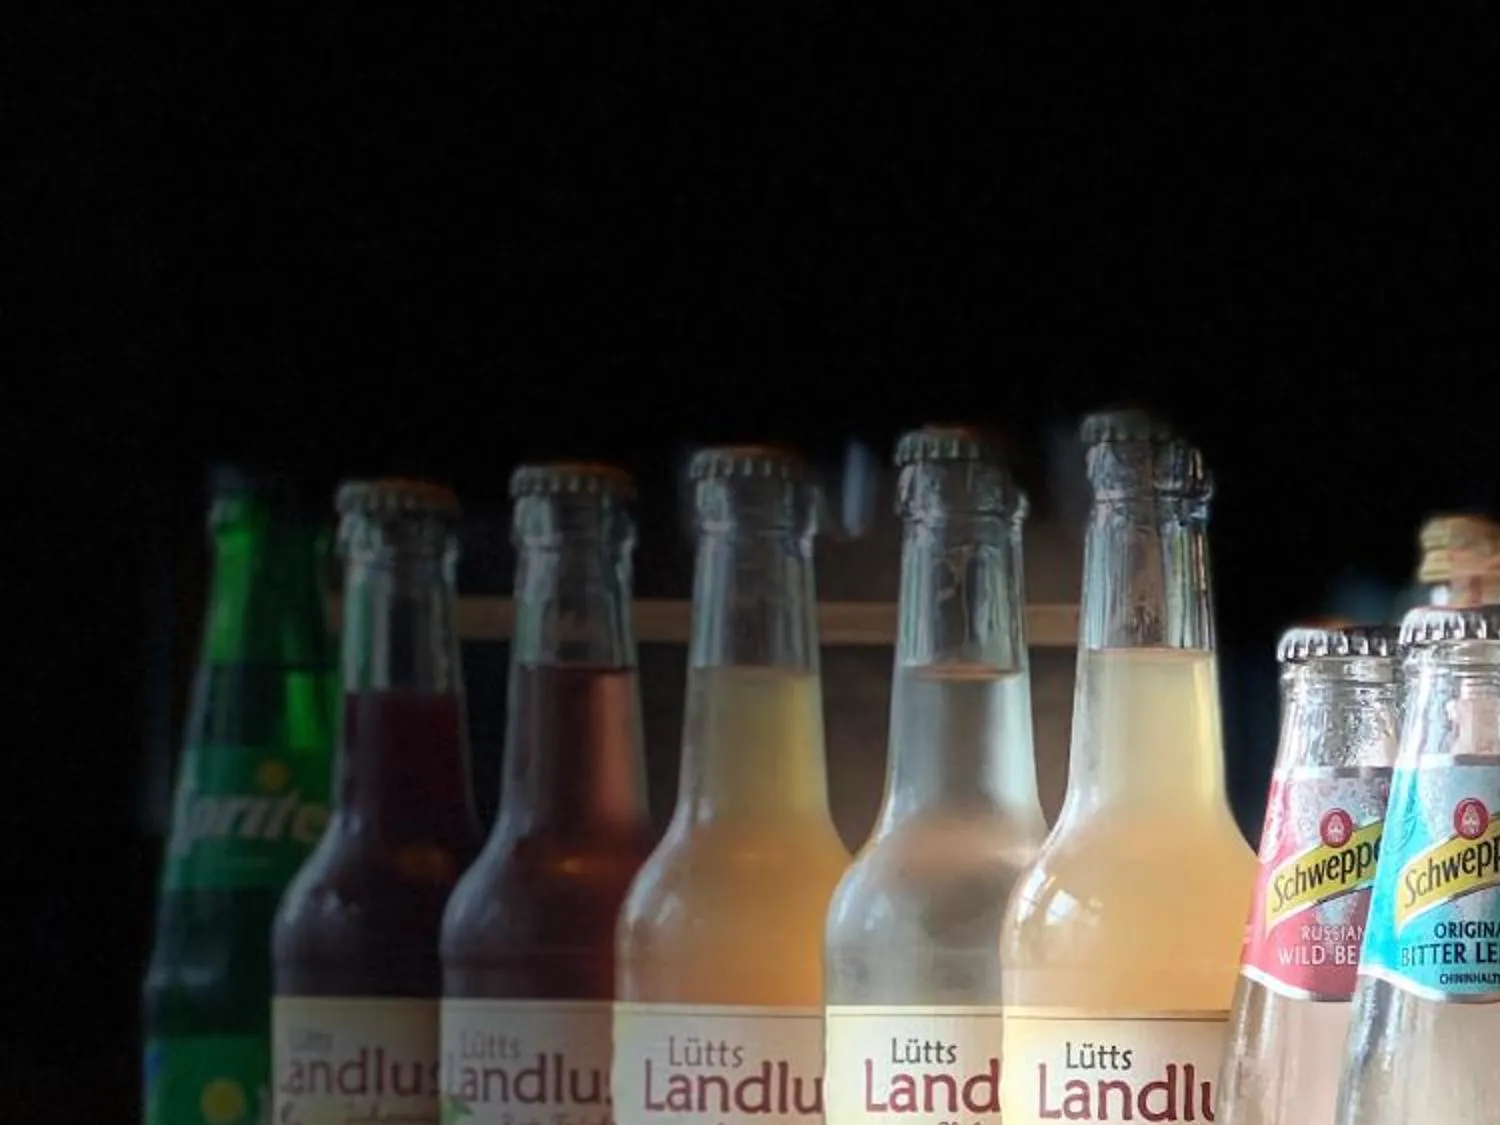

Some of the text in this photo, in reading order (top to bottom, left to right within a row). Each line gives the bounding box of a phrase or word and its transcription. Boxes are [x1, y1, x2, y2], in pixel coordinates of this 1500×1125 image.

[1278, 945, 1326, 966] WILD
[1401, 942, 1467, 968] BITTER
[667, 1035, 746, 1070] Lütts
[890, 1037, 958, 1066] Lütts
[1065, 1041, 1133, 1070] Lütts
[864, 1056, 1000, 1115] Land
